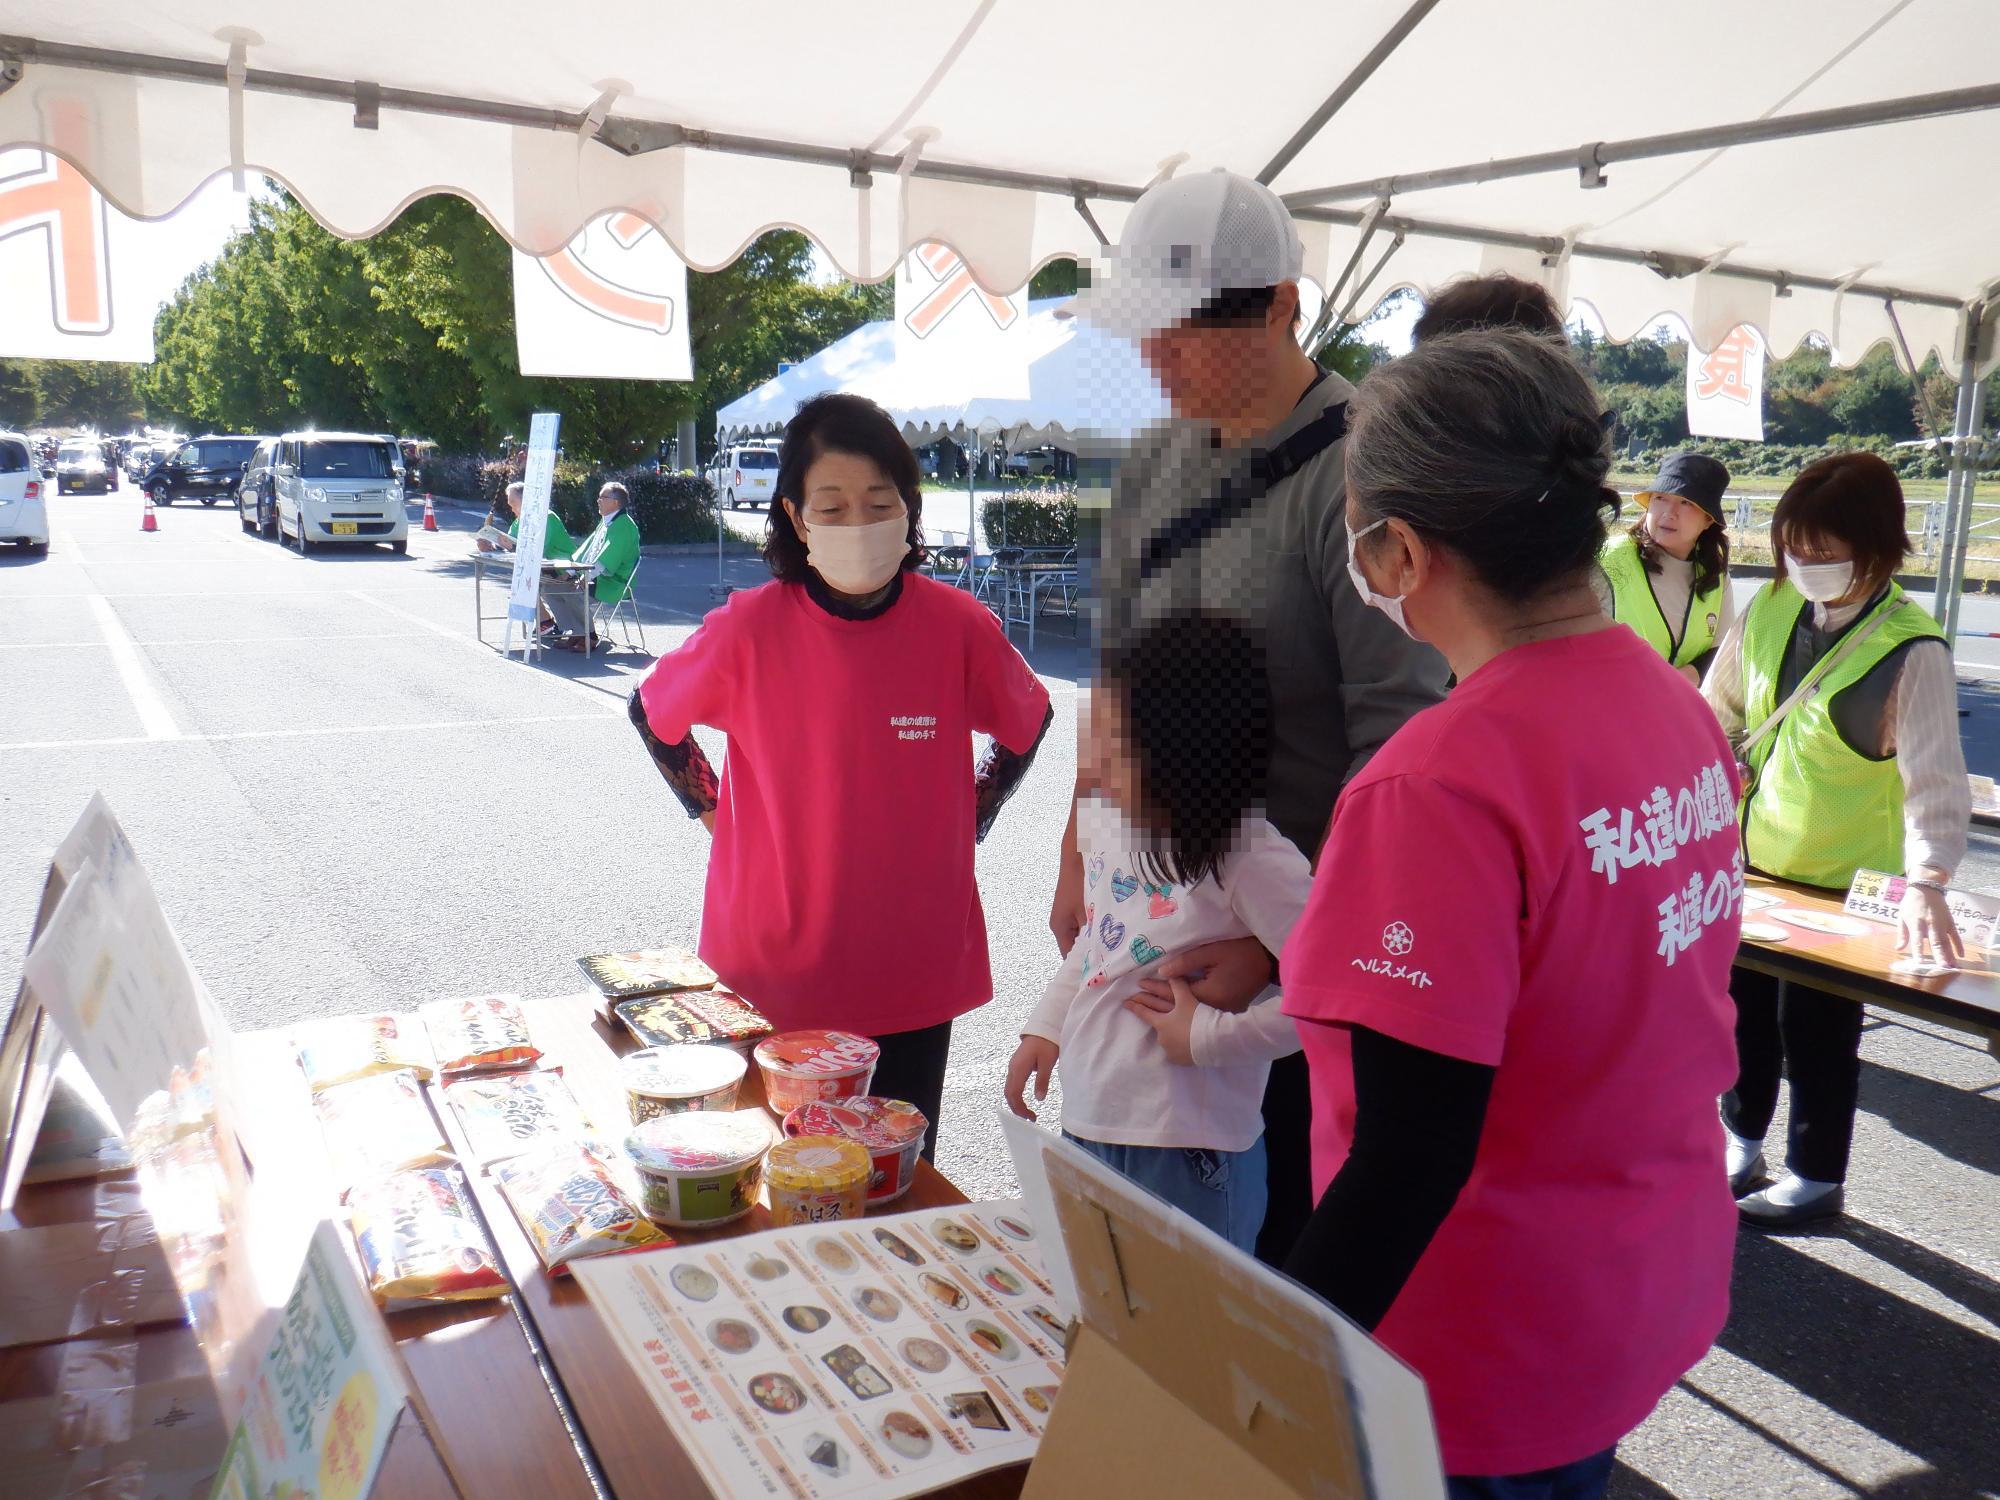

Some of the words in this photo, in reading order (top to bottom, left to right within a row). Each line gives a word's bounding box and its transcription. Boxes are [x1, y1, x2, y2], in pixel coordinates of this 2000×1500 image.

[1351, 958, 1433, 989] ヘルスメイト
